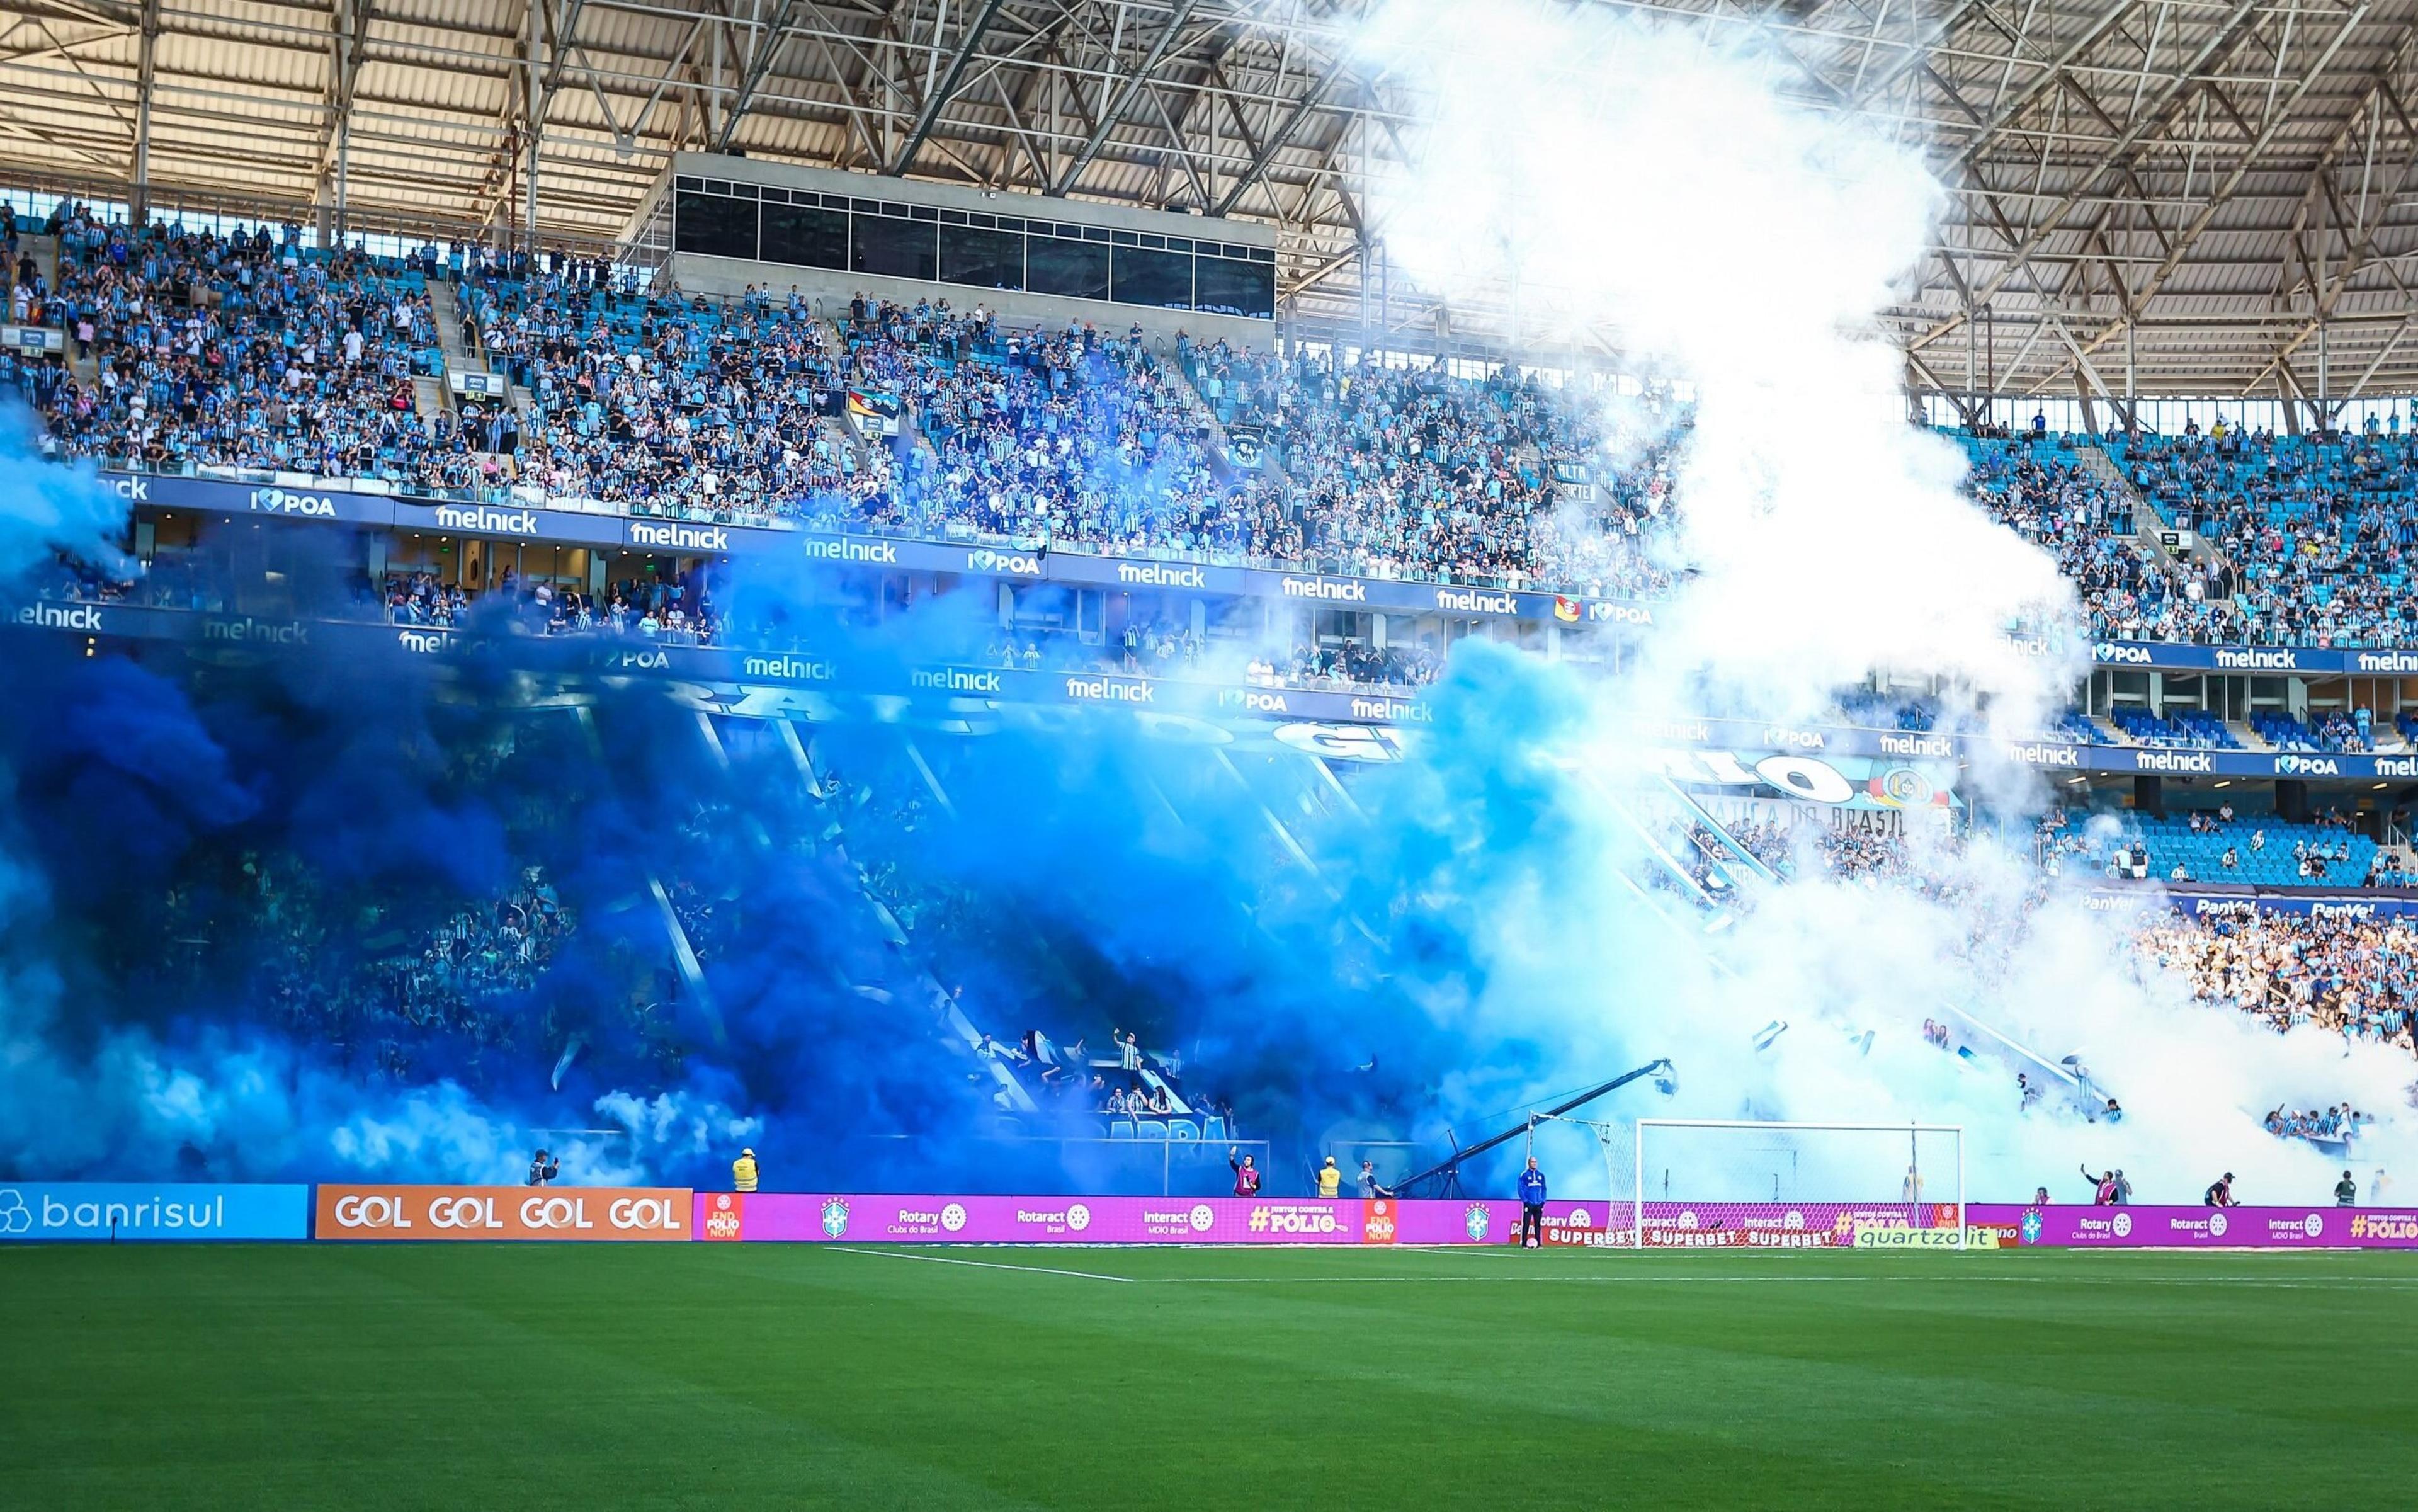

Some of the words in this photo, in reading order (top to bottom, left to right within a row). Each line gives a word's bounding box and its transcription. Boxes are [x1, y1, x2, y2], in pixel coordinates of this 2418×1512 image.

[1558, 463, 1586, 479] ALTA
[1558, 482, 1590, 500] ORTE
[251, 491, 257, 509] I
[284, 496, 336, 516] POA
[436, 506, 537, 534] melnick
[631, 522, 728, 550] melnick
[803, 538, 897, 564] melnick
[968, 554, 973, 569] I
[996, 556, 1040, 574] POA
[1118, 563, 1206, 588] melnick
[1281, 577, 1366, 601] melnick
[1437, 589, 1518, 615] melnick
[1616, 607, 1654, 625] POA
[622, 651, 670, 669] POA
[2114, 647, 2152, 664] POA
[2216, 648, 2296, 668] melnick
[743, 656, 836, 680] melnick
[911, 668, 1000, 692] melnick
[1066, 678, 1154, 703] melnick
[1246, 694, 1288, 712] POA
[1351, 698, 1433, 723] melnick
[1788, 730, 1824, 748] POA
[1880, 734, 1951, 757] melnick
[2009, 744, 2078, 766] melnick
[2136, 751, 2211, 771] melnick
[2300, 759, 2339, 776] POA
[1832, 807, 1907, 836] BRASIL
[43, 1195, 222, 1227] banrisul
[335, 1196, 411, 1228] GOL
[429, 1197, 503, 1229] GOL
[520, 1197, 593, 1229] GOL
[609, 1198, 680, 1229] GOL
[712, 1211, 735, 1220] END
[899, 1209, 939, 1225] Rotary
[1017, 1210, 1065, 1222] Rotaract
[1144, 1210, 1188, 1224] Interact
[707, 1219, 740, 1229] POLIO
[887, 1225, 907, 1233] Clubs
[909, 1225, 919, 1233] do
[919, 1225, 938, 1233] Brasil
[1047, 1225, 1065, 1233] Brasil
[1169, 1226, 1188, 1234] Brasil
[1366, 1223, 1394, 1232] POLIO
[1540, 1216, 1567, 1227] otary
[1642, 1216, 1676, 1227] otaract
[1745, 1217, 1783, 1228] Interact
[2080, 1218, 2111, 1232] Rotary
[2171, 1219, 2208, 1229] Rotaract
[2269, 1219, 2303, 1230] Interact
[710, 1228, 735, 1237] NOW
[1549, 1229, 1636, 1246] SUPERBET
[1652, 1231, 1736, 1247] SUPERBET
[1748, 1230, 1831, 1247] SUPERBET
[2072, 1231, 2087, 1239] Clubs
[2088, 1231, 2096, 1239] do
[2096, 1231, 2111, 1239] Brasil
[2288, 1232, 2303, 1240] Brasil
